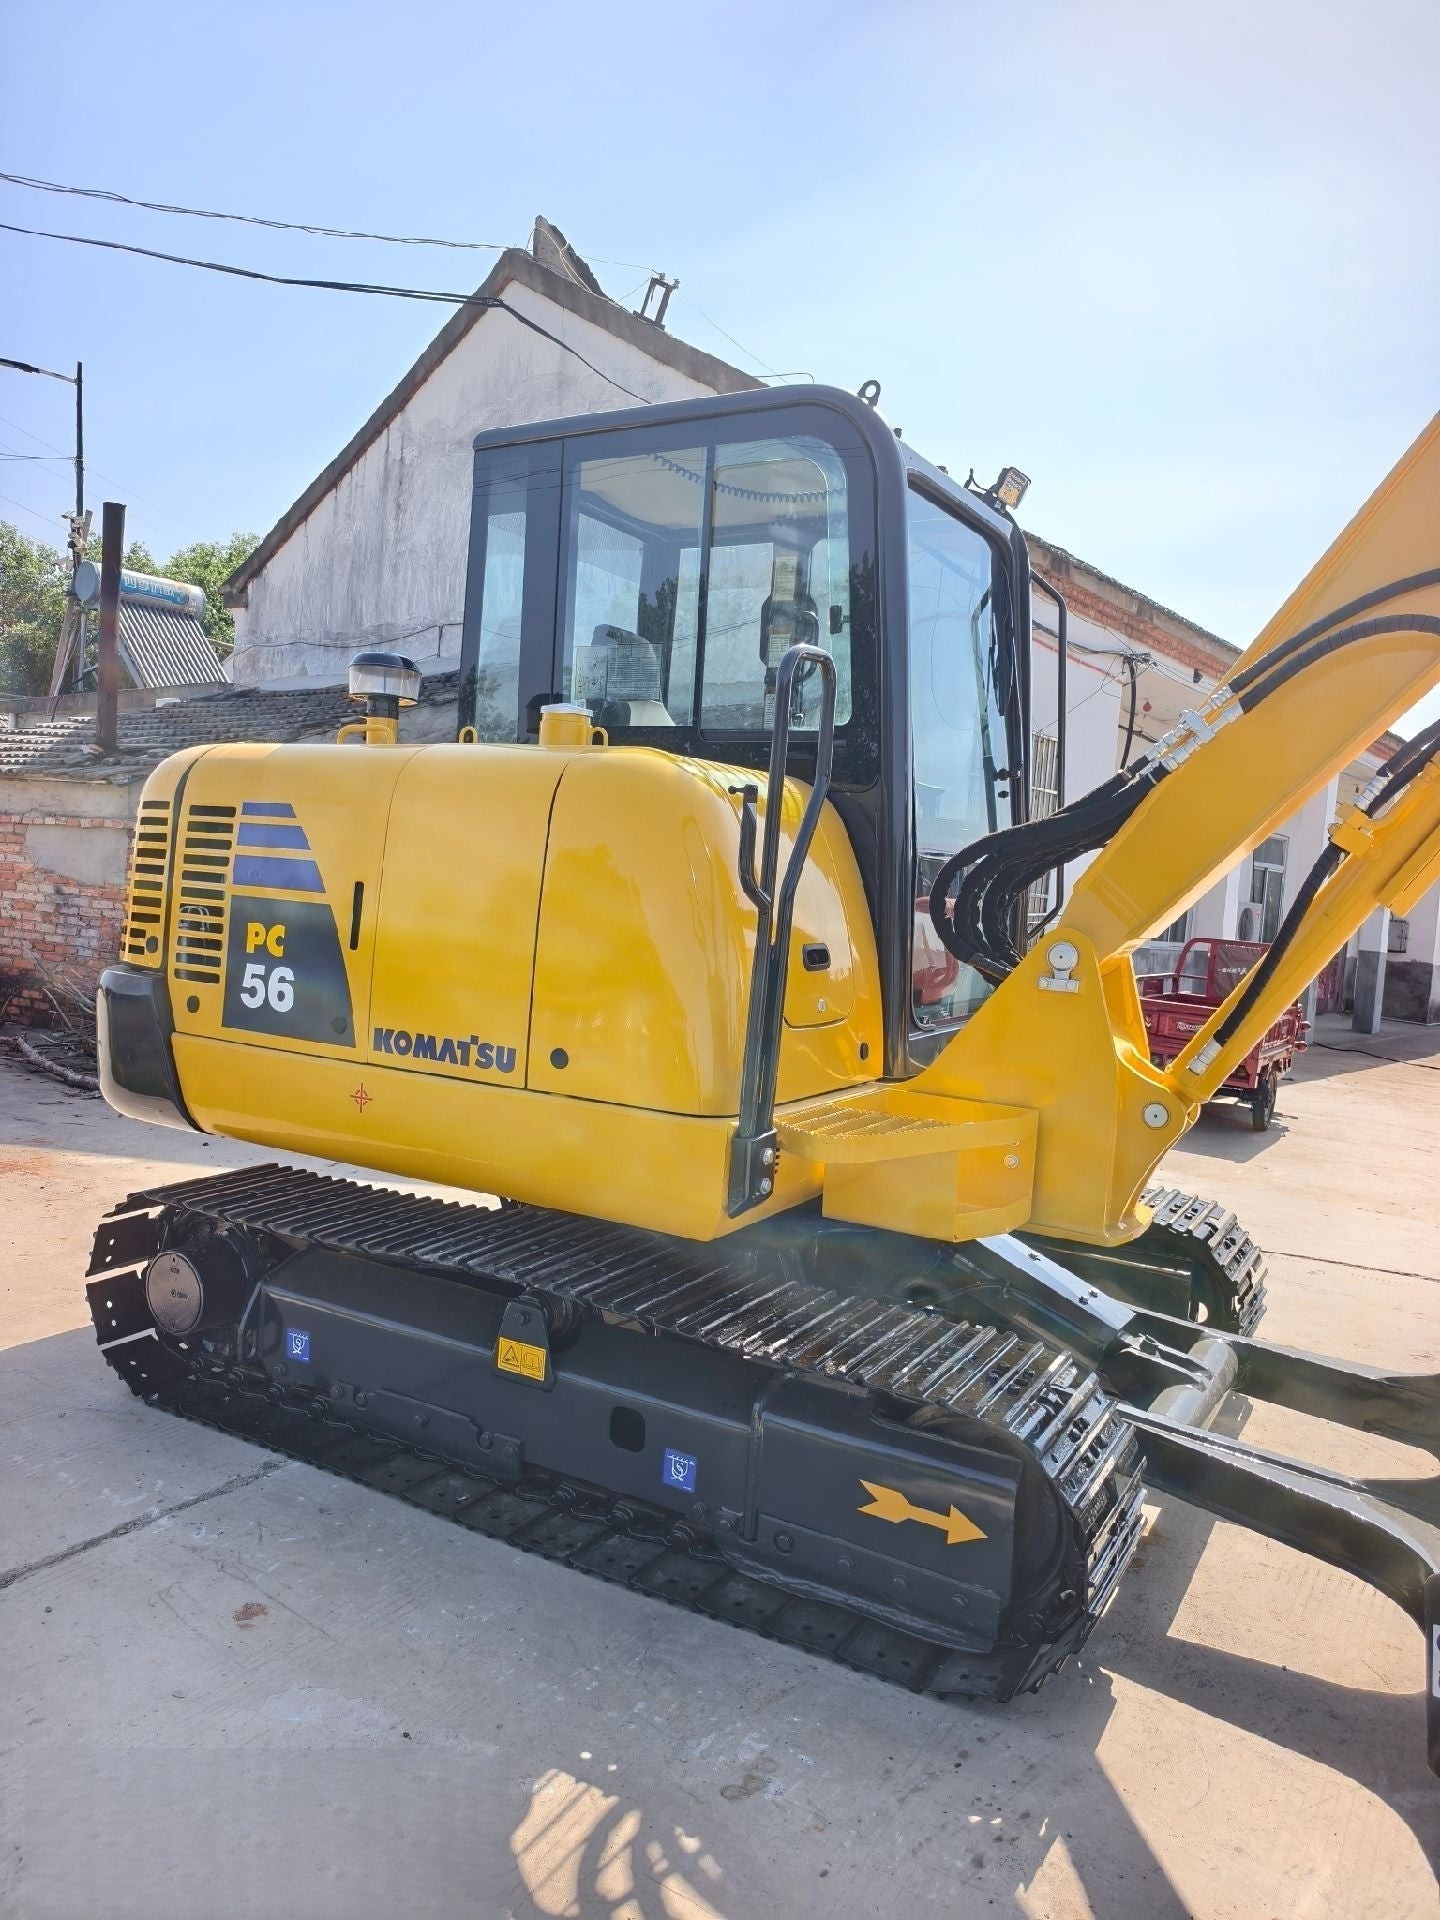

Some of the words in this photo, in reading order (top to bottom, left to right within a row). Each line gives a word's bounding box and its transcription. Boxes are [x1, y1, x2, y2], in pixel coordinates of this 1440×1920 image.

[245, 922, 286, 958] PC
[240, 963, 295, 1013] 56
[373, 1027, 517, 1073] KOMATSU
